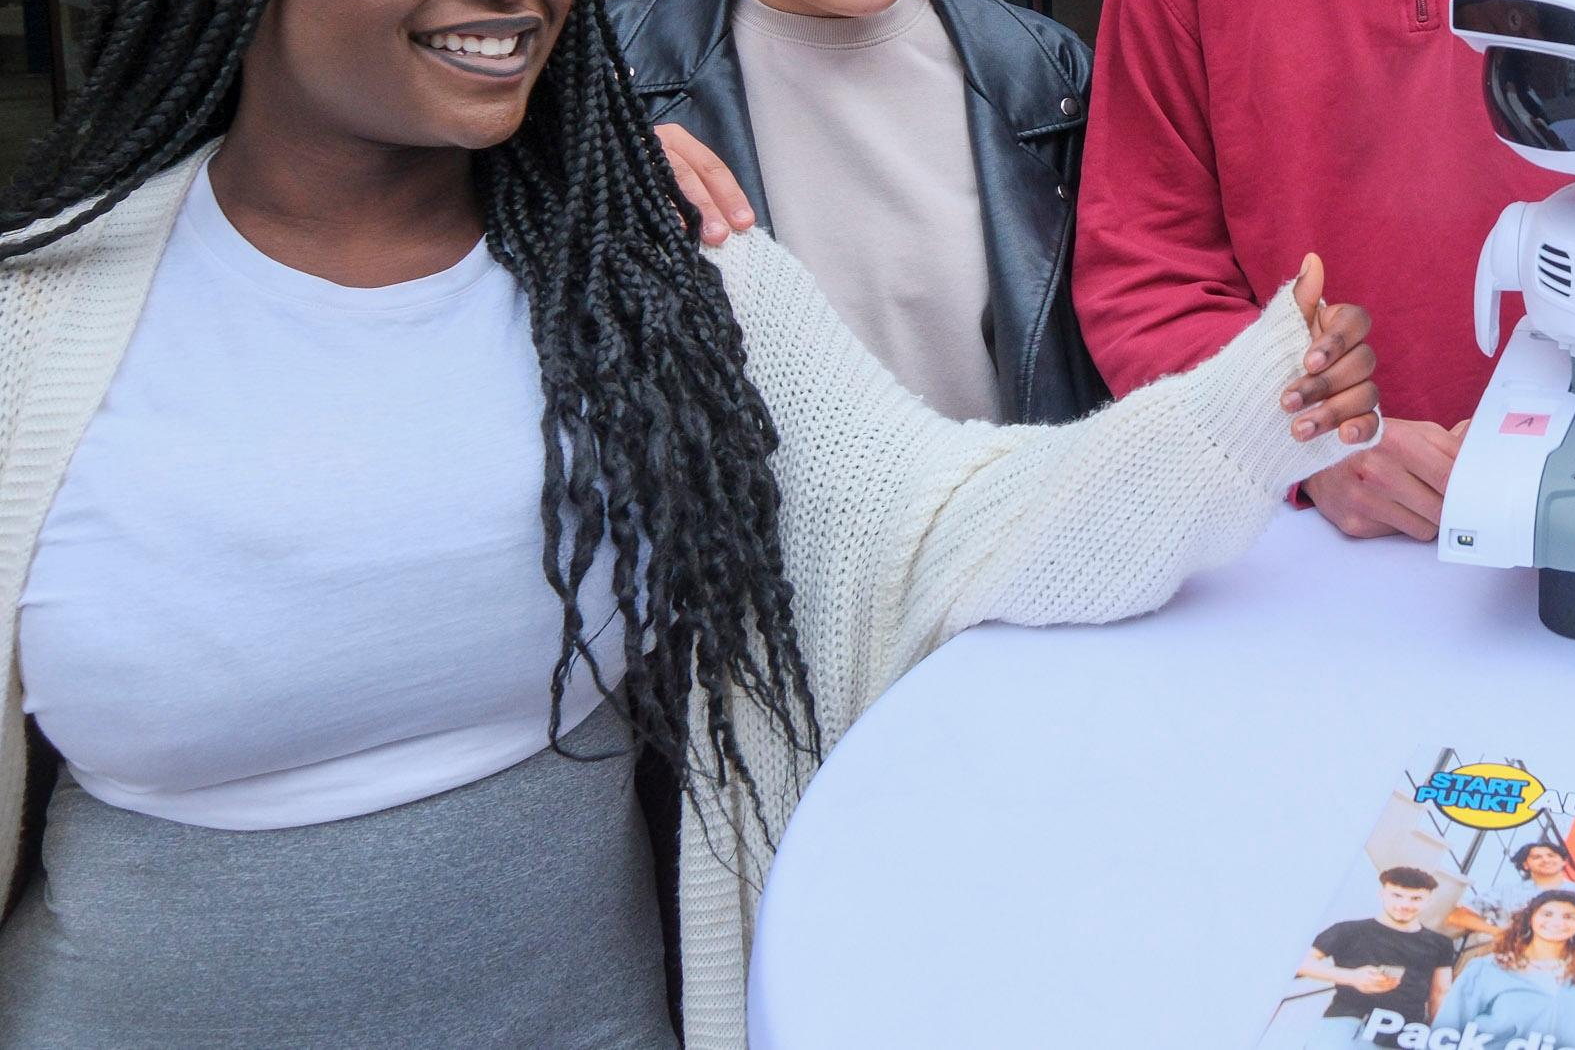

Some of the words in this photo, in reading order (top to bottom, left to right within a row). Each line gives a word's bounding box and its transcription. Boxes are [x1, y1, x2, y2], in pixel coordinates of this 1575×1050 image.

[1430, 771, 1531, 797] START
[1414, 785, 1526, 814] PUNKT
[1363, 1007, 1495, 1050] Pack
[1504, 1031, 1575, 1050] di
